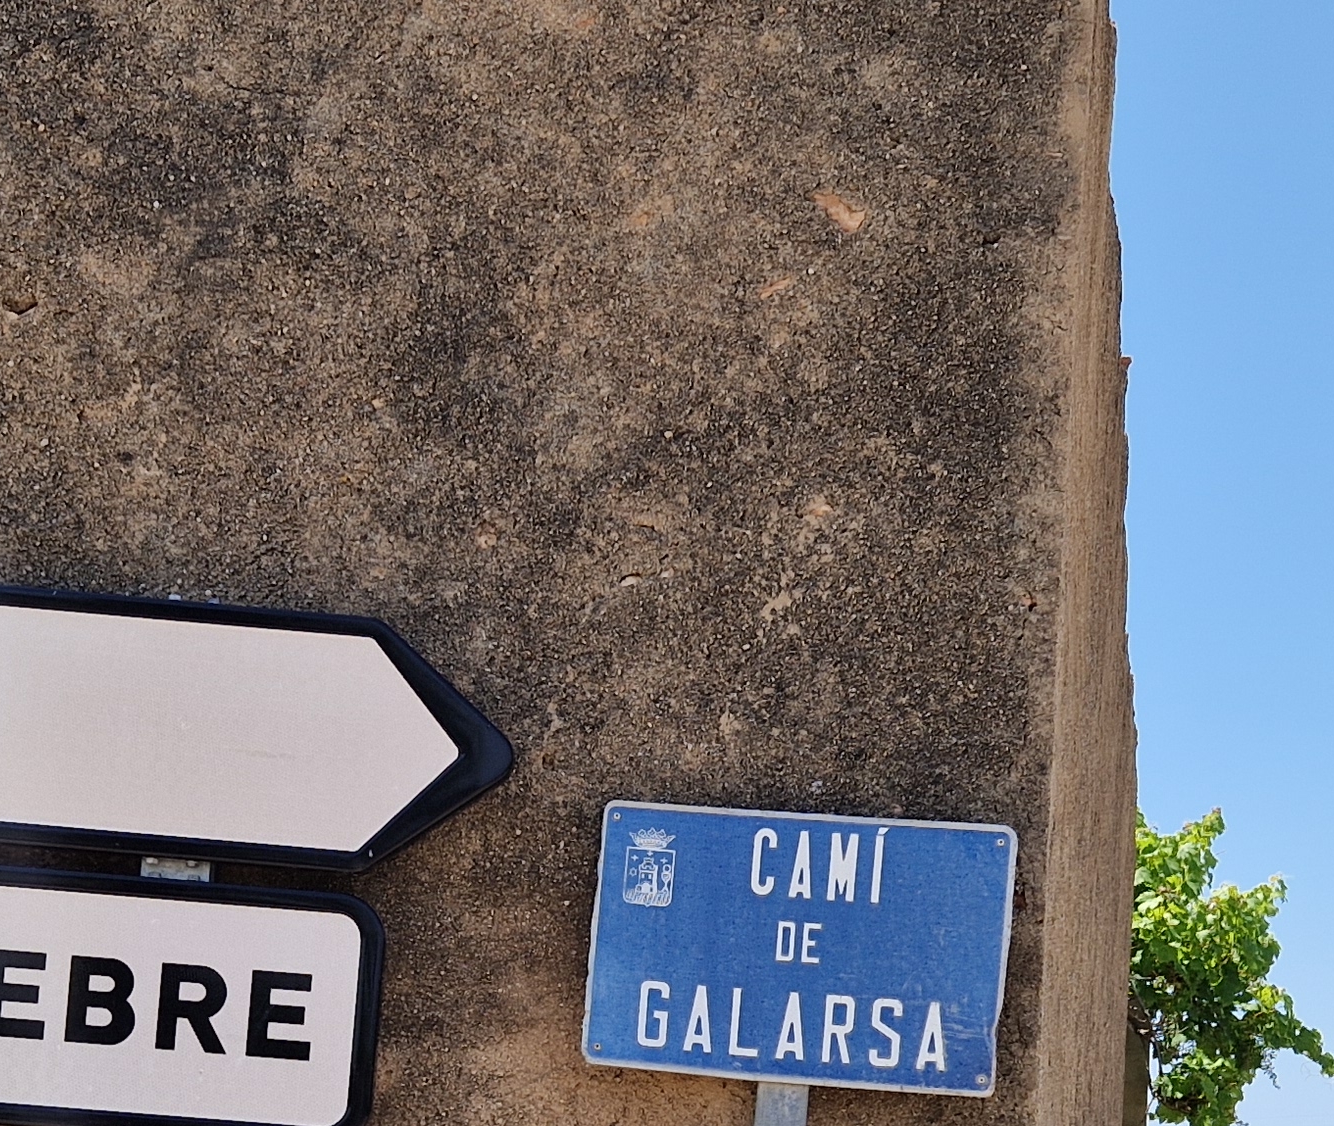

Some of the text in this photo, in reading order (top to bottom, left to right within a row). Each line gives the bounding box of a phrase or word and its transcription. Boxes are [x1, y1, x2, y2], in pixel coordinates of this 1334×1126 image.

[750, 827, 890, 904] CAMÍ
[775, 920, 823, 964] DE
[637, 980, 946, 1072] GALARSA
